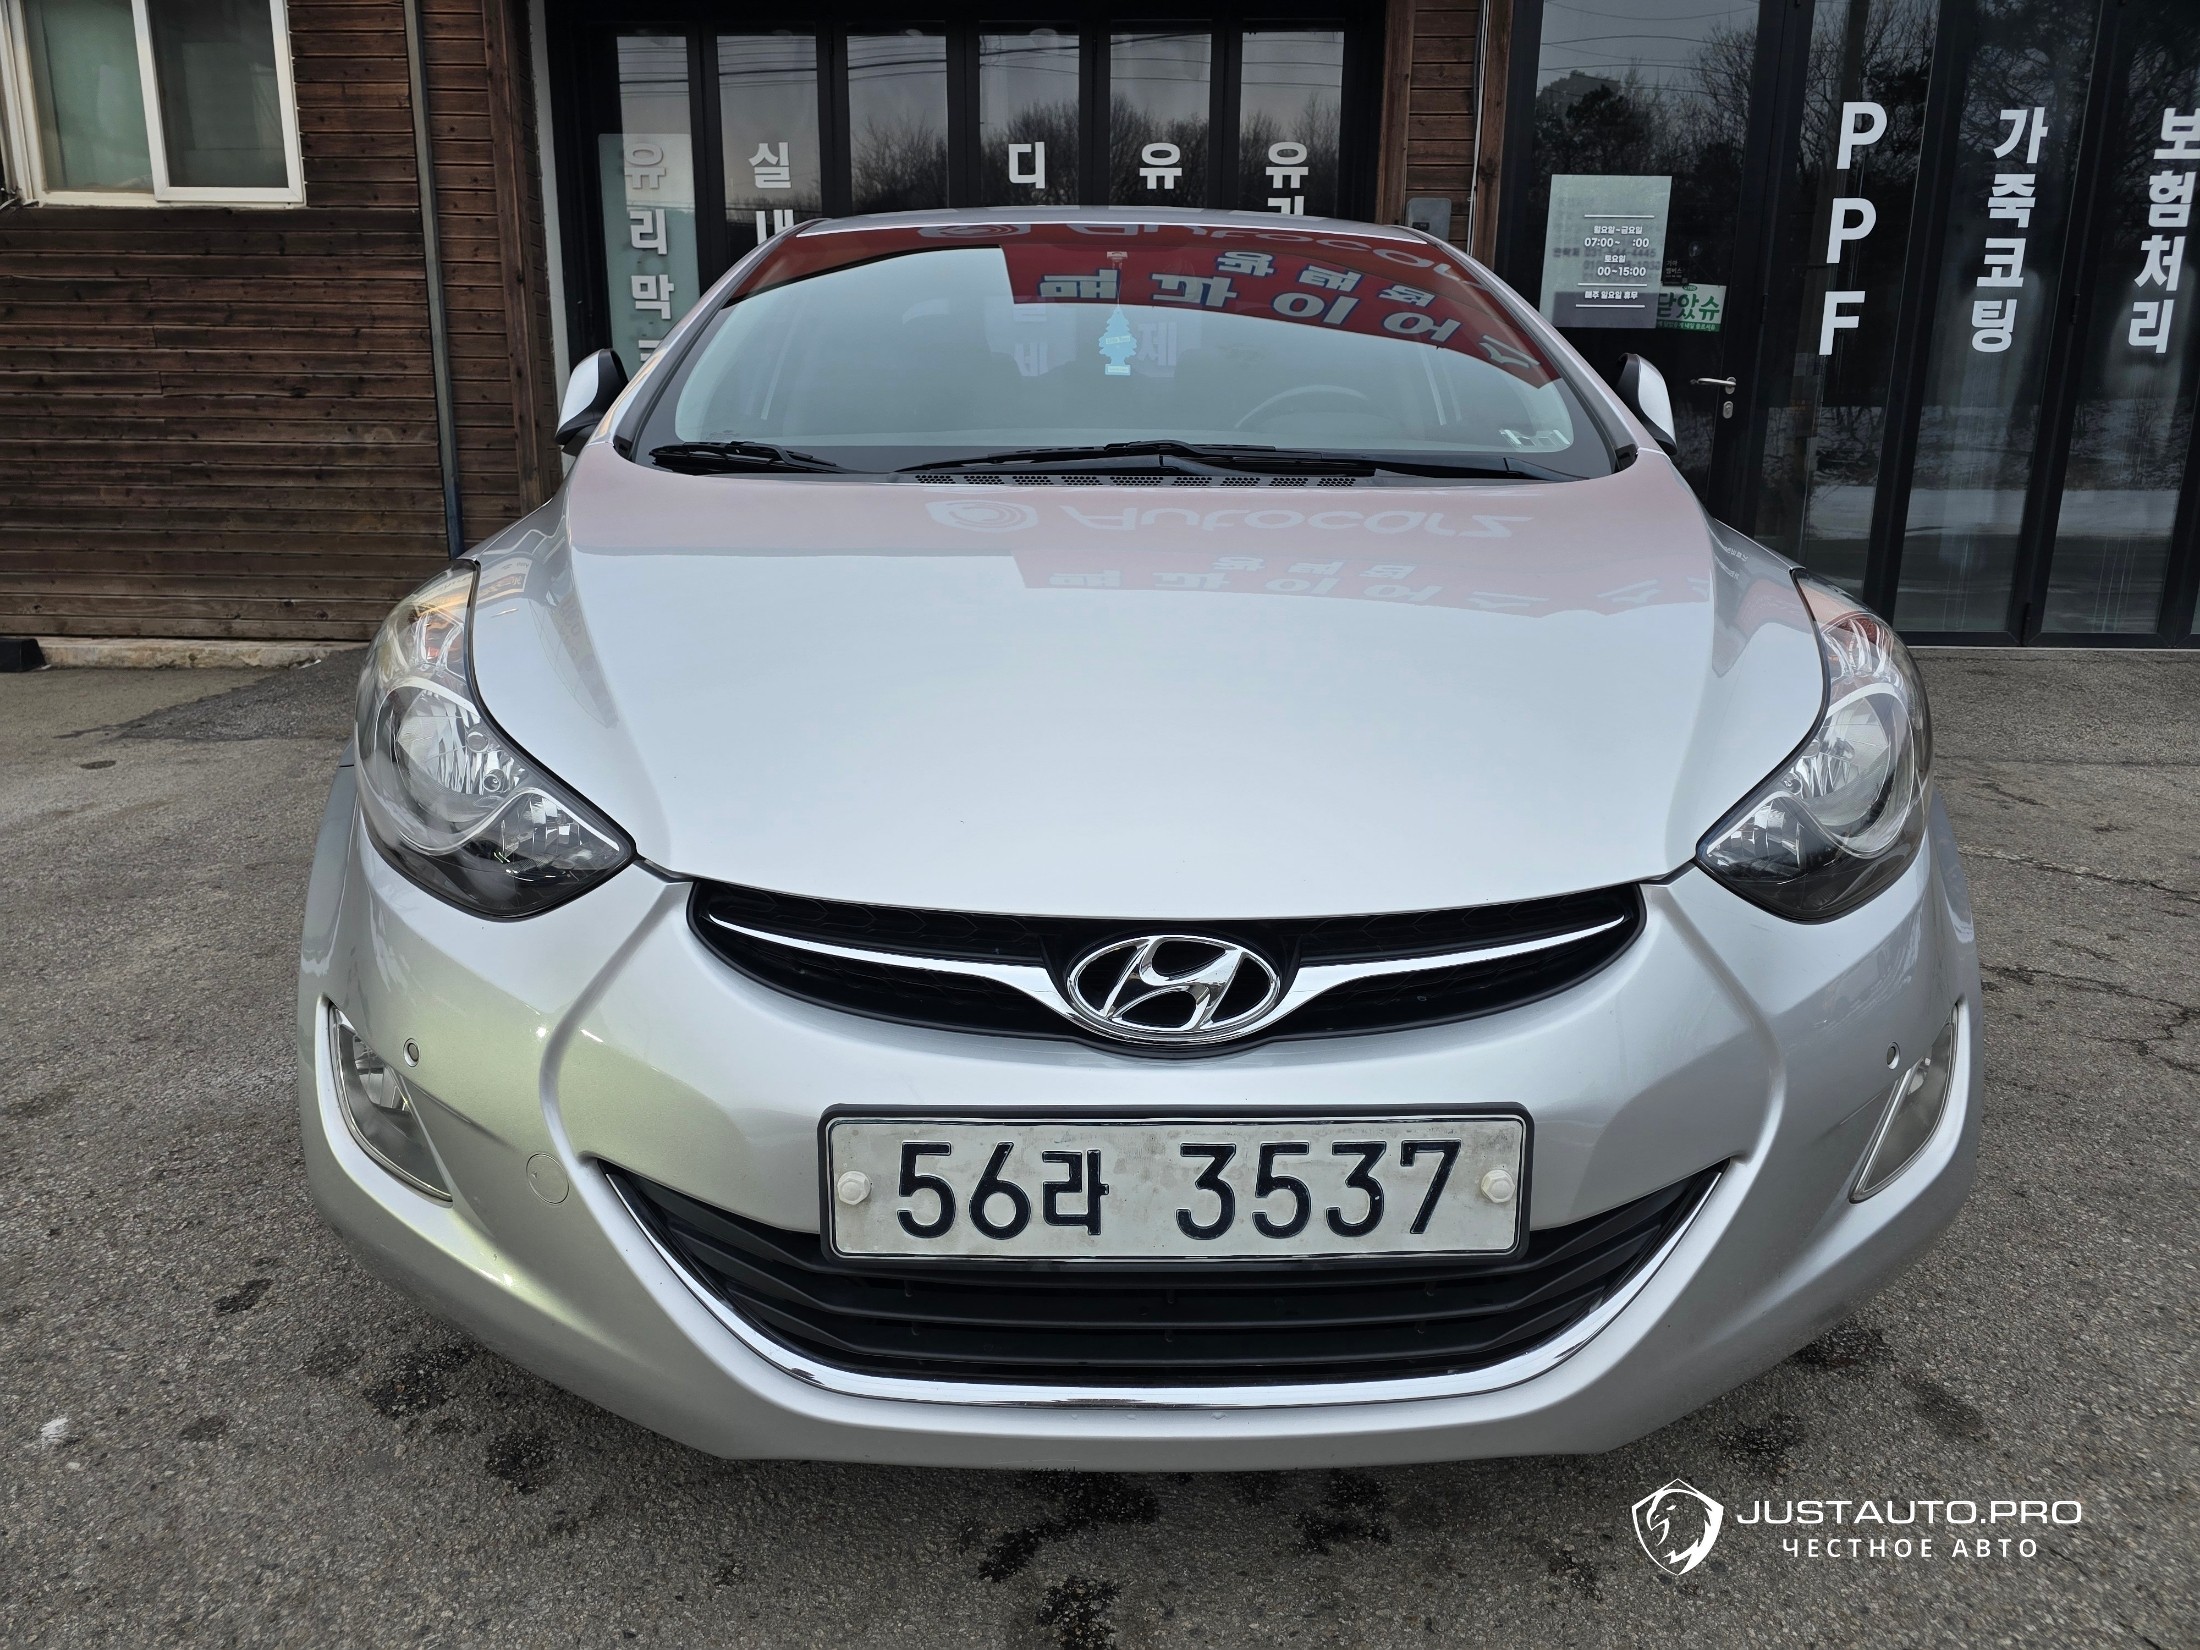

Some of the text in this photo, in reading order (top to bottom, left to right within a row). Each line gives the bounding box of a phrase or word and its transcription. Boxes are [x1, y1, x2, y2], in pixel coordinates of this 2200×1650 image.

[1604, 255, 1626, 263] 토요일
[1971, 106, 2049, 353] 가죽코팅
[2127, 106, 2200, 354] 보험처리
[1601, 291, 1622, 299] 일요일
[1624, 291, 1639, 299] 휴무
[897, 1140, 1463, 1241] 56라 3537
